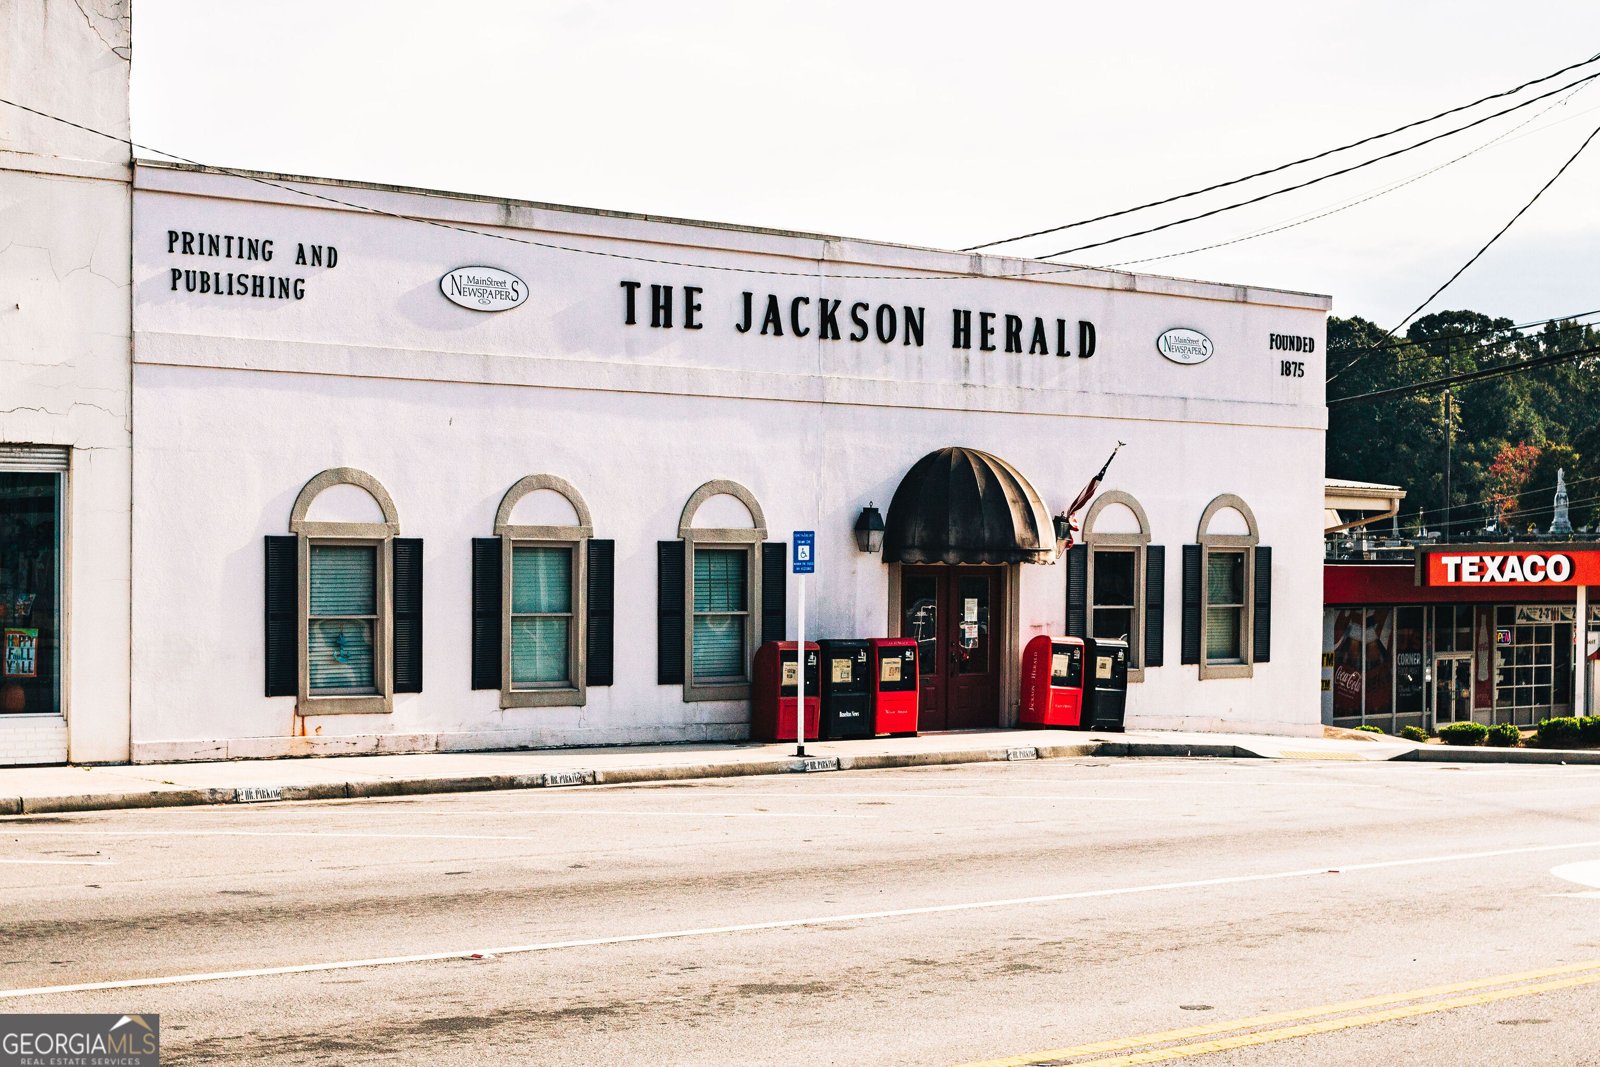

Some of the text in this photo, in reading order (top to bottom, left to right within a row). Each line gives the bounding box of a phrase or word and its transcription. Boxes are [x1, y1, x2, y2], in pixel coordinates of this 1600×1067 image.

[167, 230, 338, 269] PRINTING AND
[171, 268, 305, 300] PUBLISHING
[466, 275, 507, 287] MainStreet
[620, 281, 1096, 359] THE JACKSON HERALD
[1269, 333, 1314, 353] FOUNDED
[1280, 360, 1304, 378] 1875
[1441, 554, 1573, 583] TEXACO
[1322, 653, 1334, 666] TM
[1397, 653, 1420, 666] CORNER
